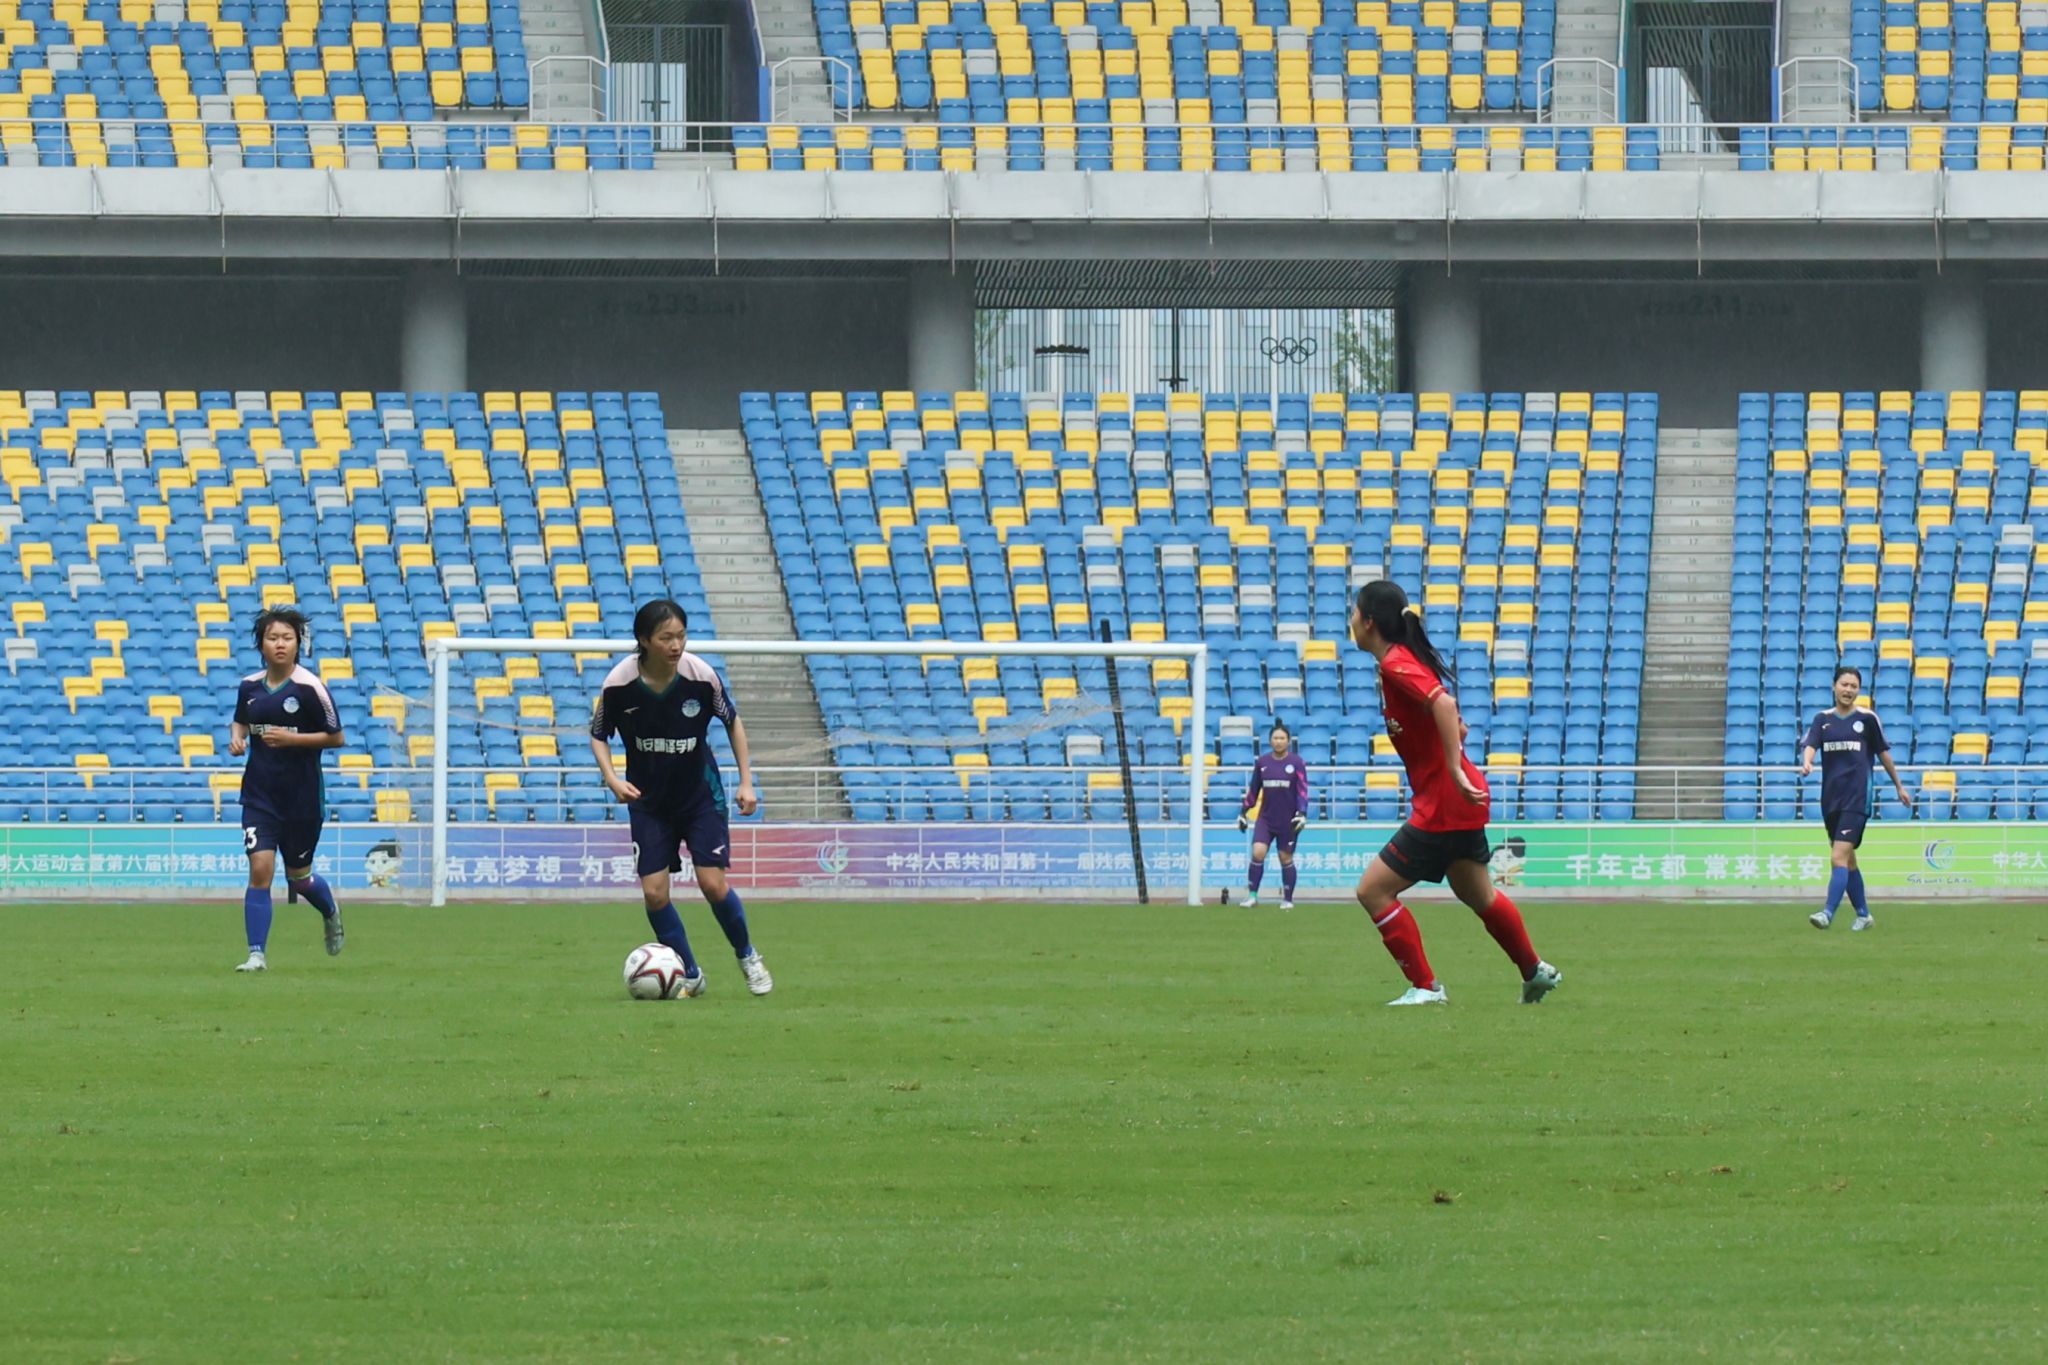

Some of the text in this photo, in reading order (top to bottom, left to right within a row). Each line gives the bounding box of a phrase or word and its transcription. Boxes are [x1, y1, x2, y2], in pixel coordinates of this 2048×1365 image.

[243, 826, 258, 850] 3
[446, 855, 697, 883] 点亮梦想 为爱航
[1565, 853, 1825, 880] 千年古都 常来长安
[1992, 851, 2048, 869] 中华人
